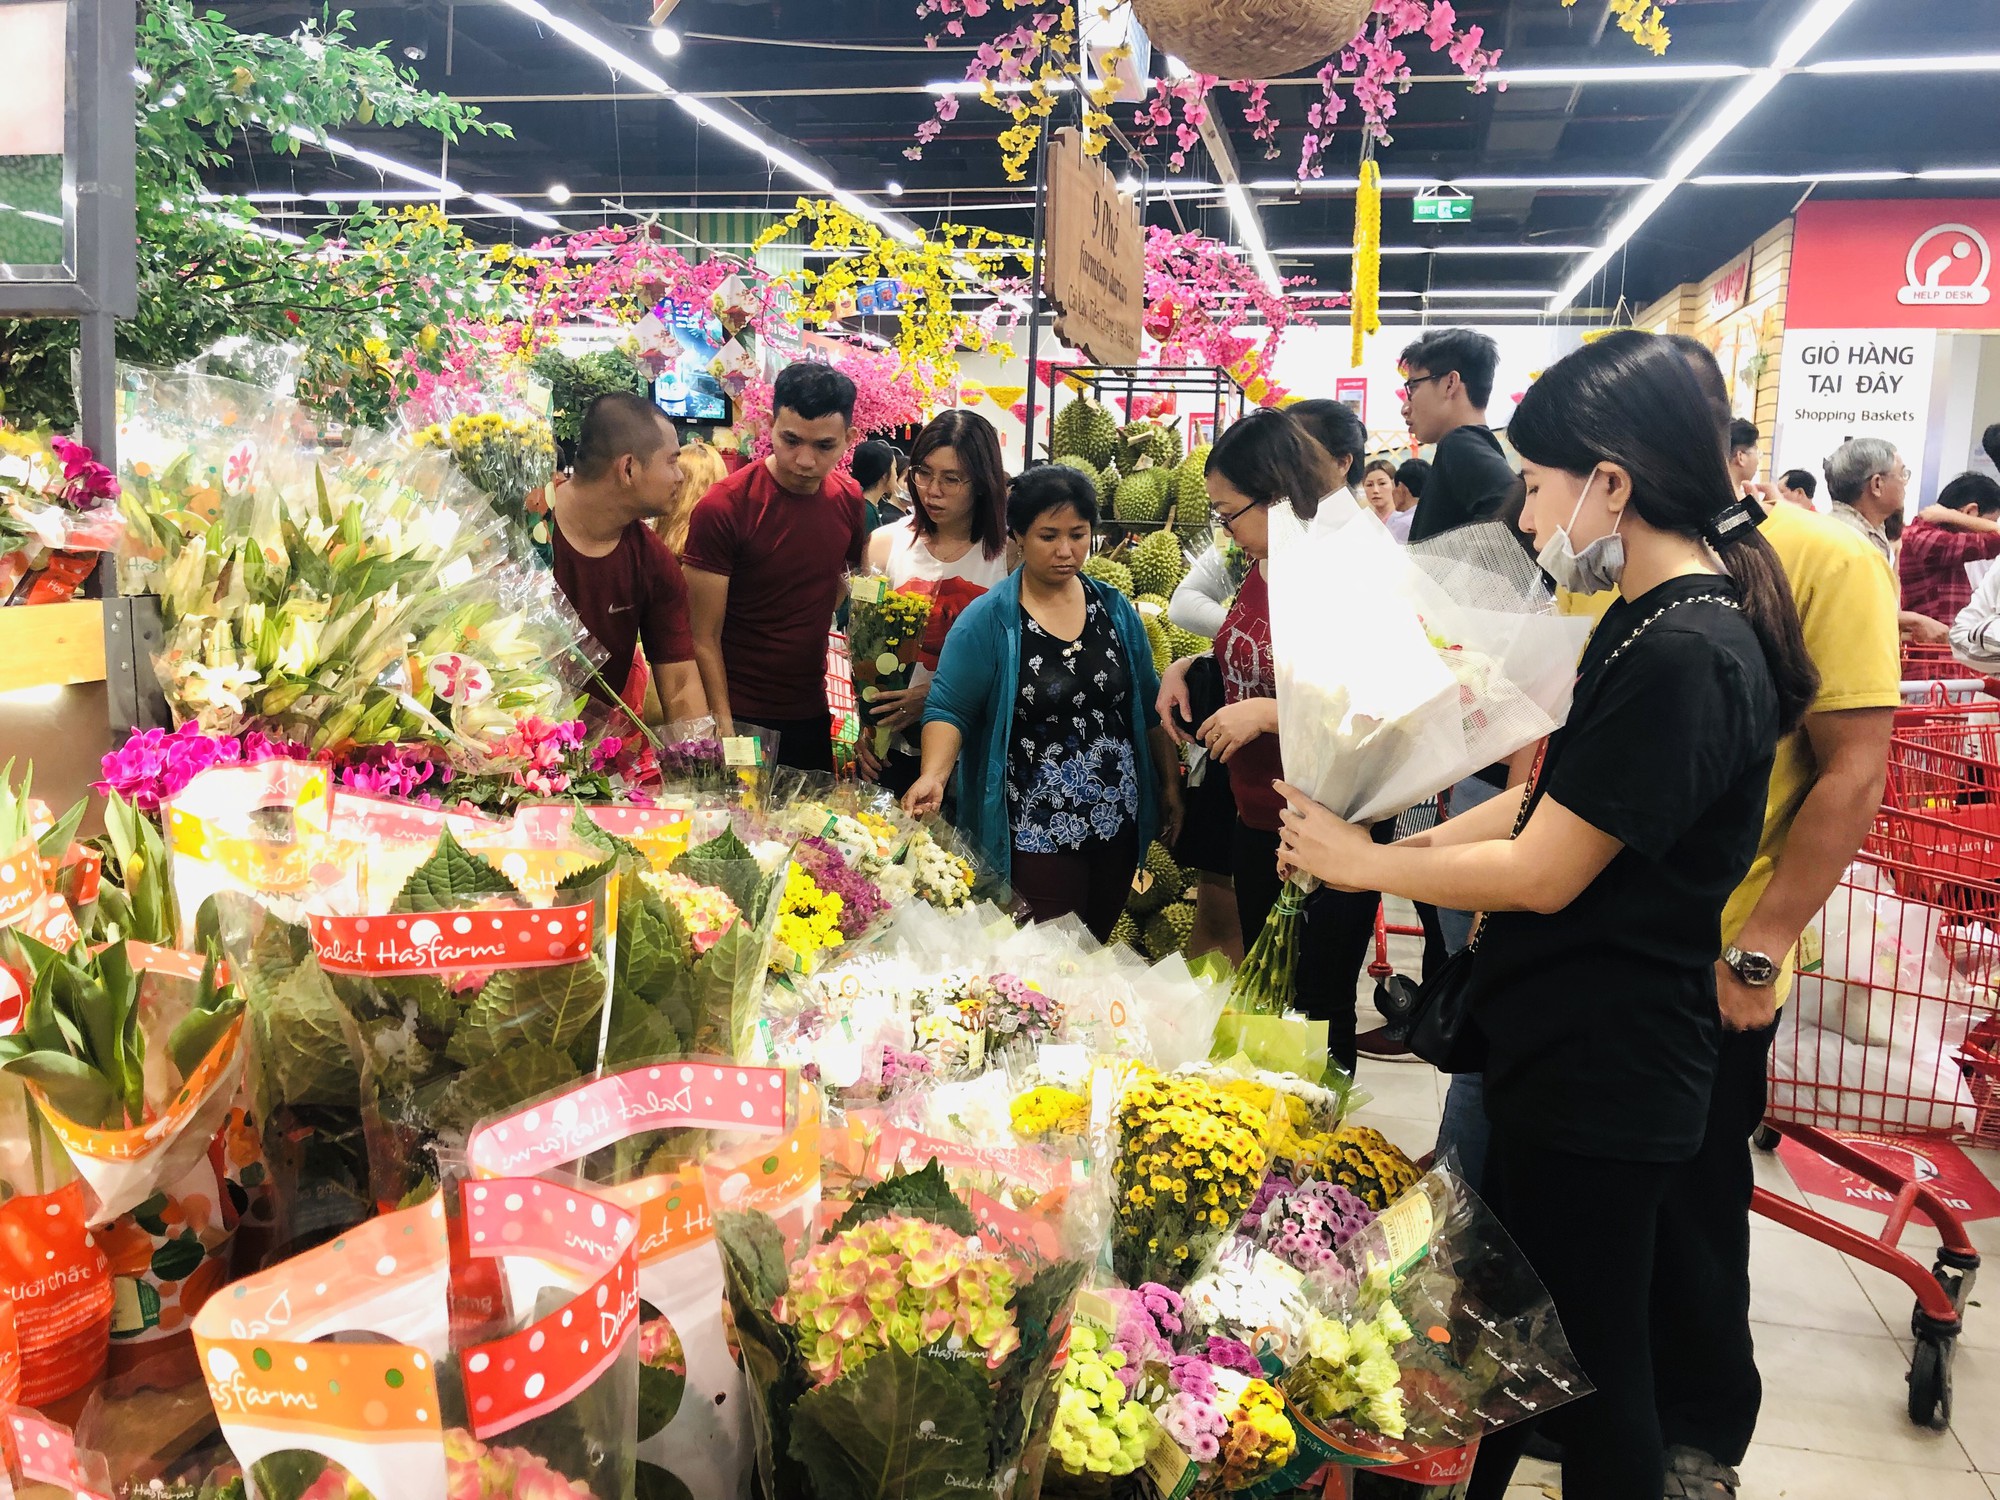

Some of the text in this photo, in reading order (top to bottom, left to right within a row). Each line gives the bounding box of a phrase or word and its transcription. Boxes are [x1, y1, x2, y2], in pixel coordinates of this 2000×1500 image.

[1092, 190, 1100, 239] 9
[1418, 205, 1436, 215] EXIT
[1913, 290, 1974, 300] HELP DESK
[1847, 341, 1914, 365] HÀNG
[1808, 371, 1904, 397] TẠI ĐÂY
[1795, 408, 1915, 423] Shopping Baskets
[46, 580, 65, 596] Hoa
[311, 932, 504, 967] Dalat Hasfarm
[47, 1262, 93, 1292] chất
[601, 1268, 639, 1349] Dalat
[1429, 1461, 1468, 1479] Dalat
[944, 1472, 983, 1490] Dalat
